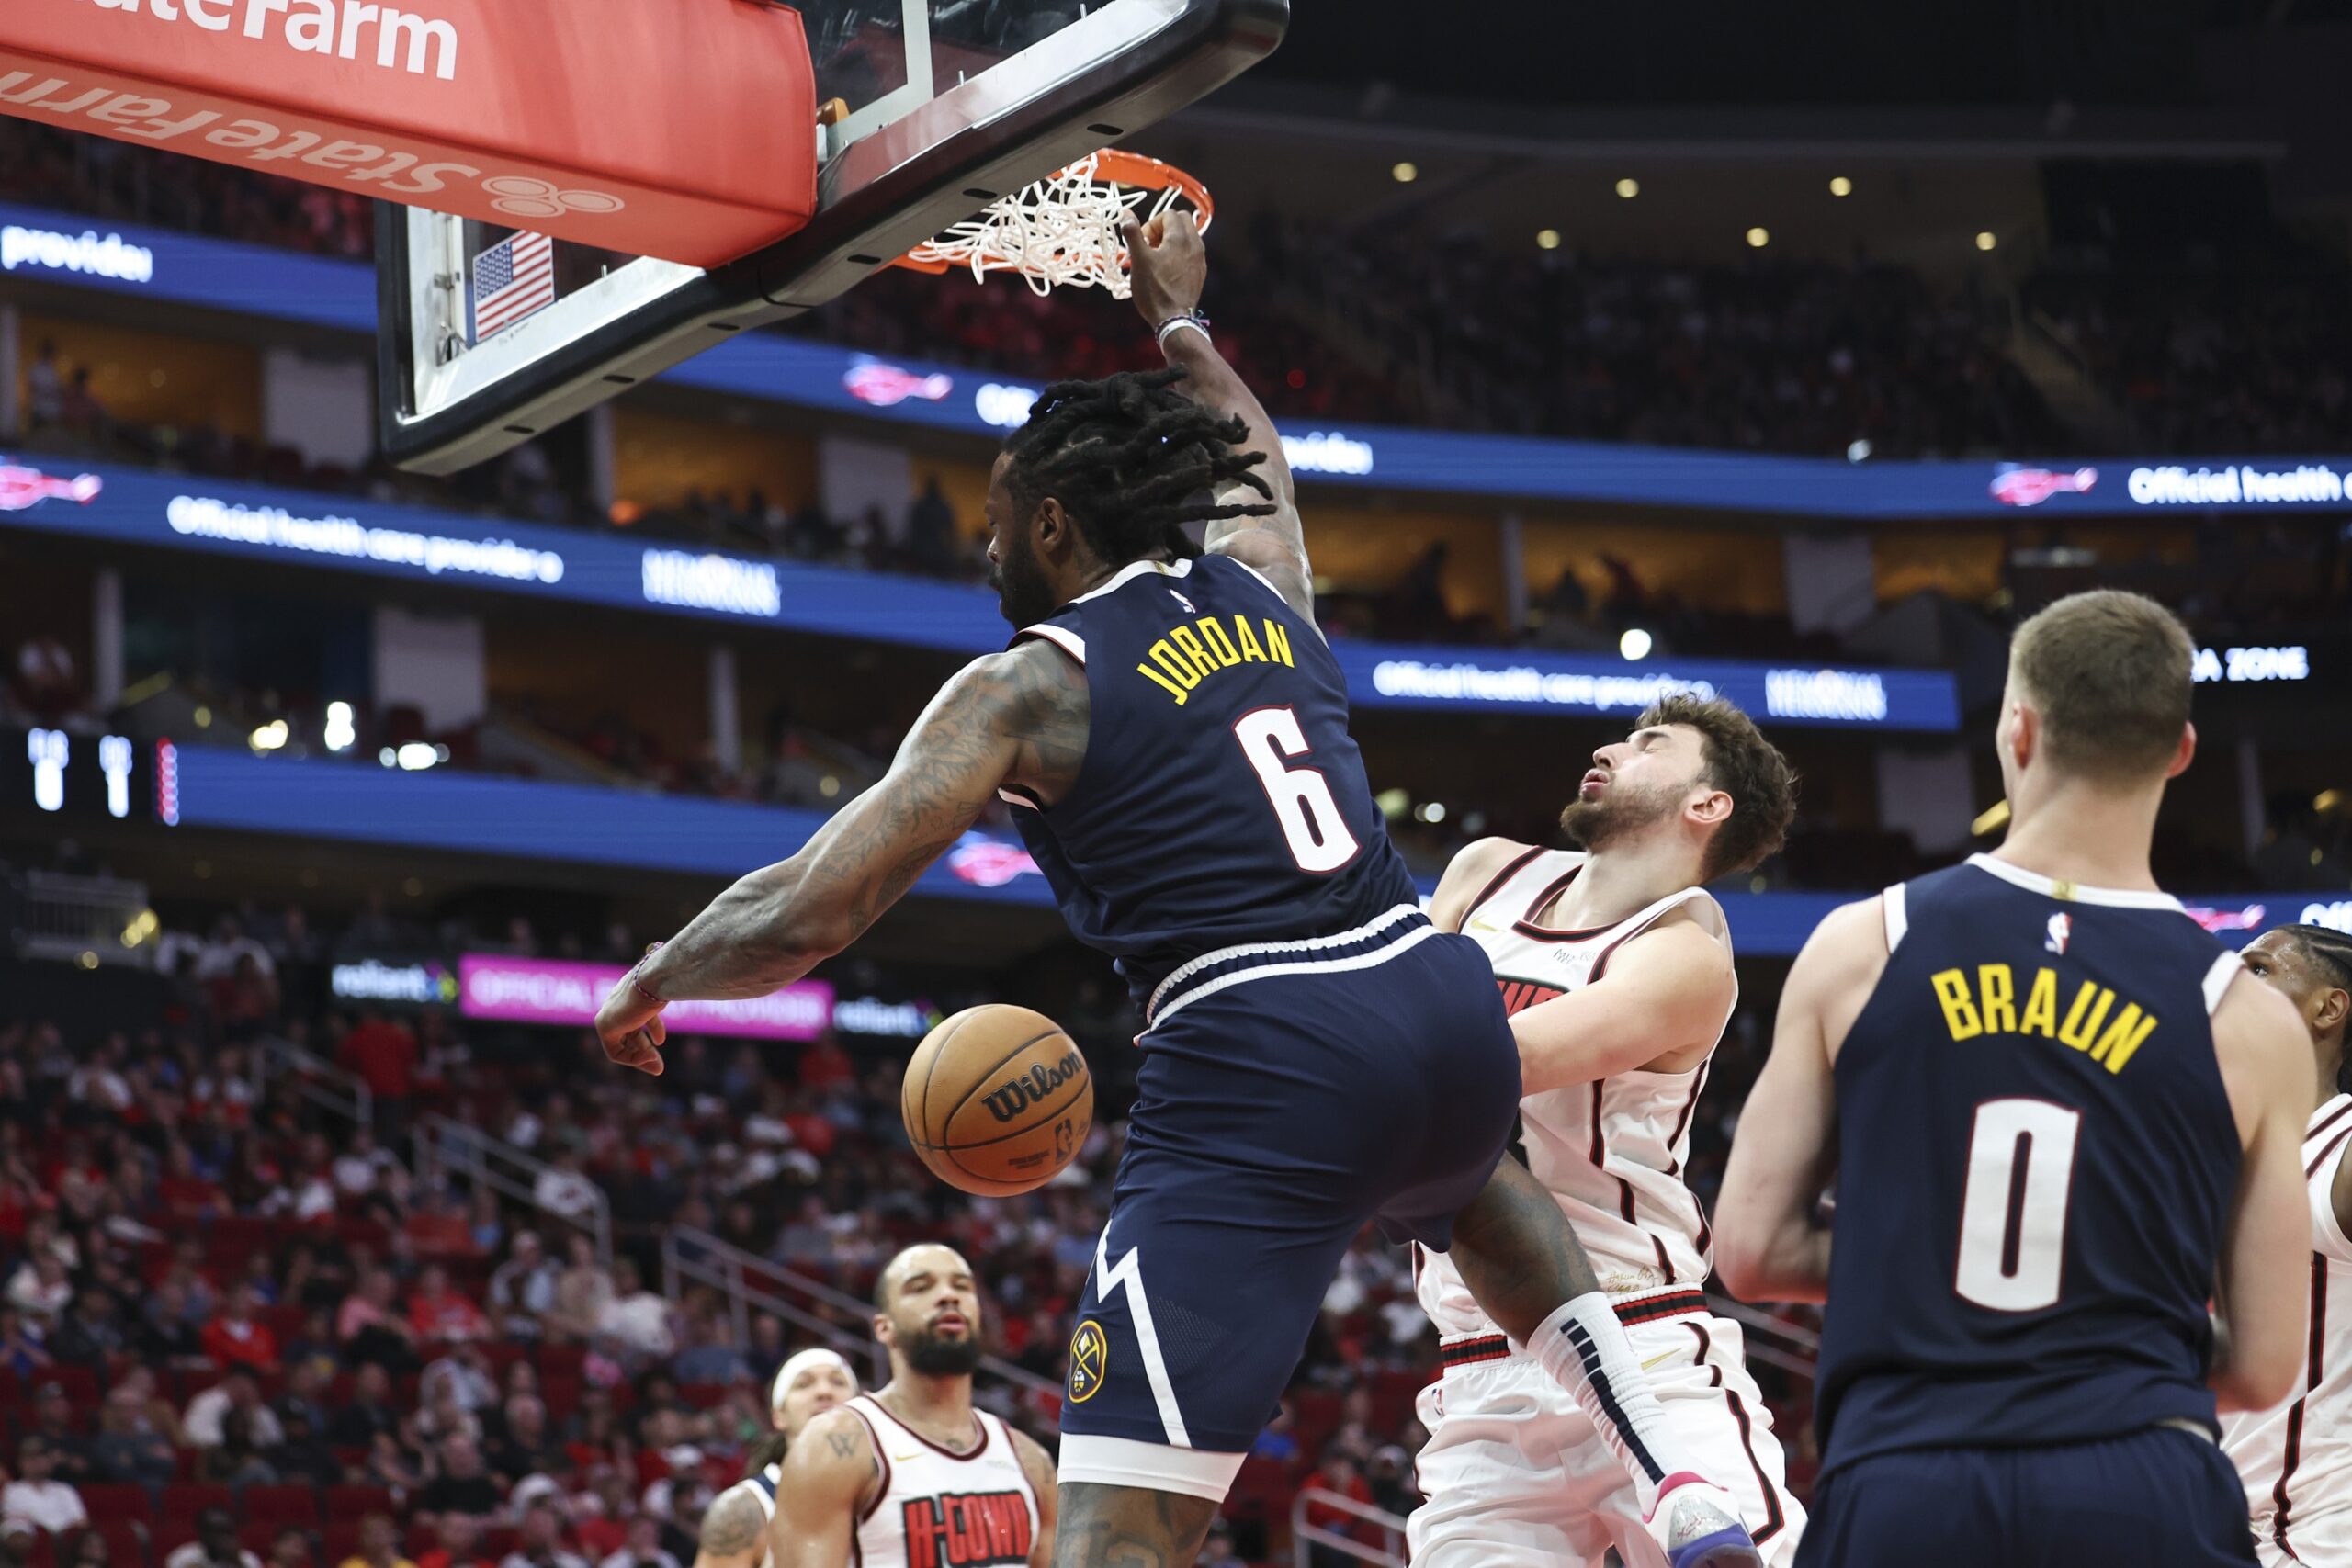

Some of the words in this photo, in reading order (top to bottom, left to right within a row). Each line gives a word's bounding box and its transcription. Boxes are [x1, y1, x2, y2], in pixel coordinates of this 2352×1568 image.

[1, 225, 153, 283] provider
[2128, 465, 2242, 505] Official
[2242, 465, 2343, 503] health
[1136, 615, 1295, 706] JORDAN
[2224, 646, 2310, 682] ZONE
[1231, 703, 1363, 874] 6
[1930, 963, 2158, 1075] BRAUN
[980, 1051, 1083, 1123] Wilson
[1953, 1095, 2083, 1314] 0
